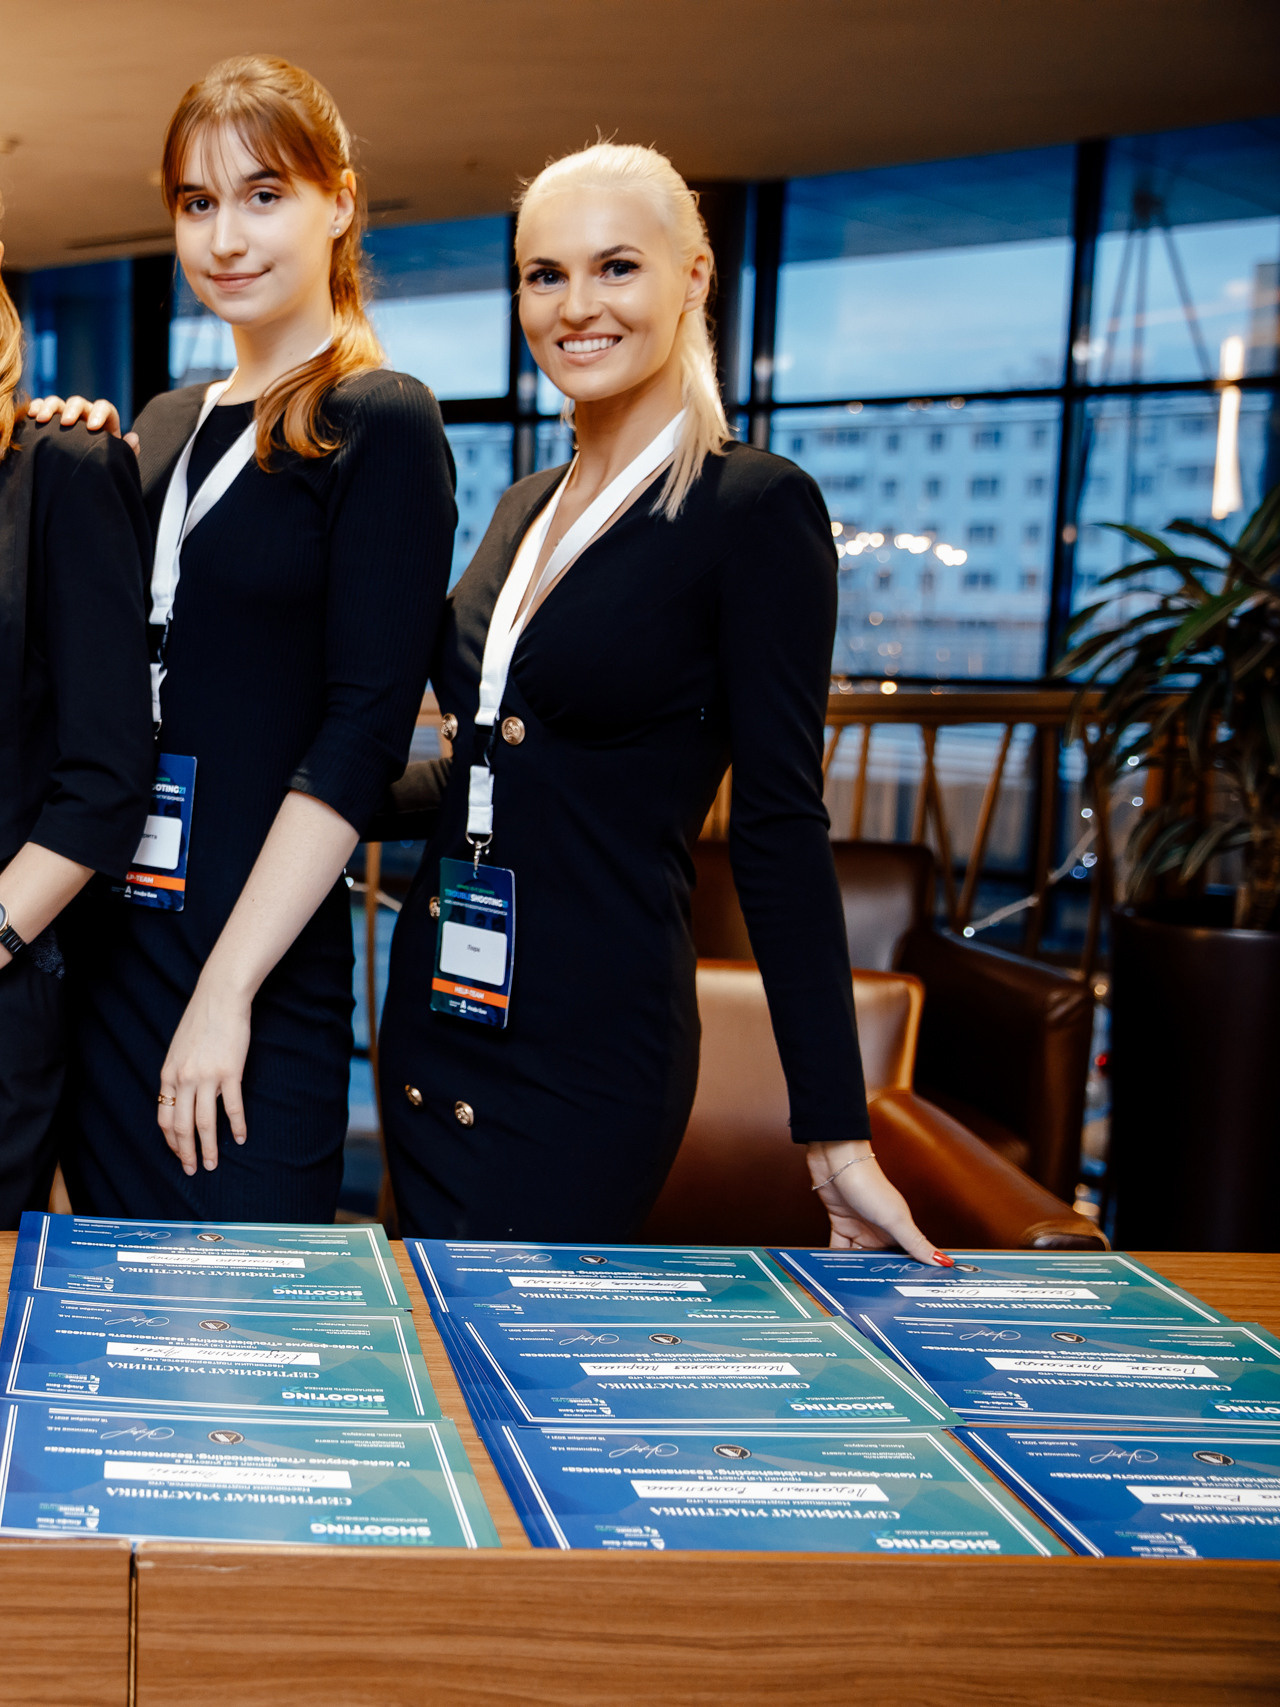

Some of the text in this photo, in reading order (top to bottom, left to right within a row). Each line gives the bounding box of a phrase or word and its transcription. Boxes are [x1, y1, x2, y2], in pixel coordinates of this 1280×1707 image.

[126, 873, 154, 884] LP-TEAM
[118, 1266, 304, 1278] СЕРТИФИКАТ УЧАСТНИКА
[272, 1288, 362, 1296] SHOOTING
[610, 1294, 711, 1302] СЕРТИФИКАТ
[54, 1329, 105, 1337] бизнеса»
[285, 1342, 358, 1350] Кейс-форуме
[107, 1361, 318, 1379] СЕРТИФИКАТ УЧАСТНИКА
[1005, 1376, 1234, 1391] СЕРТИФИКАТ УЧАСТНИКА
[281, 1391, 384, 1402] SHOOTING
[281, 1398, 385, 1408] TROUBLE
[1212, 1404, 1280, 1414] OTING
[106, 1486, 351, 1505] СЕРТИФИКАТ УЧАСТНИКА
[648, 1506, 902, 1519] СЕРТИФИКАТ УЧАСТНИКА
[310, 1523, 430, 1535] SHOOTING
[873, 1538, 1000, 1547] SHOOTING
